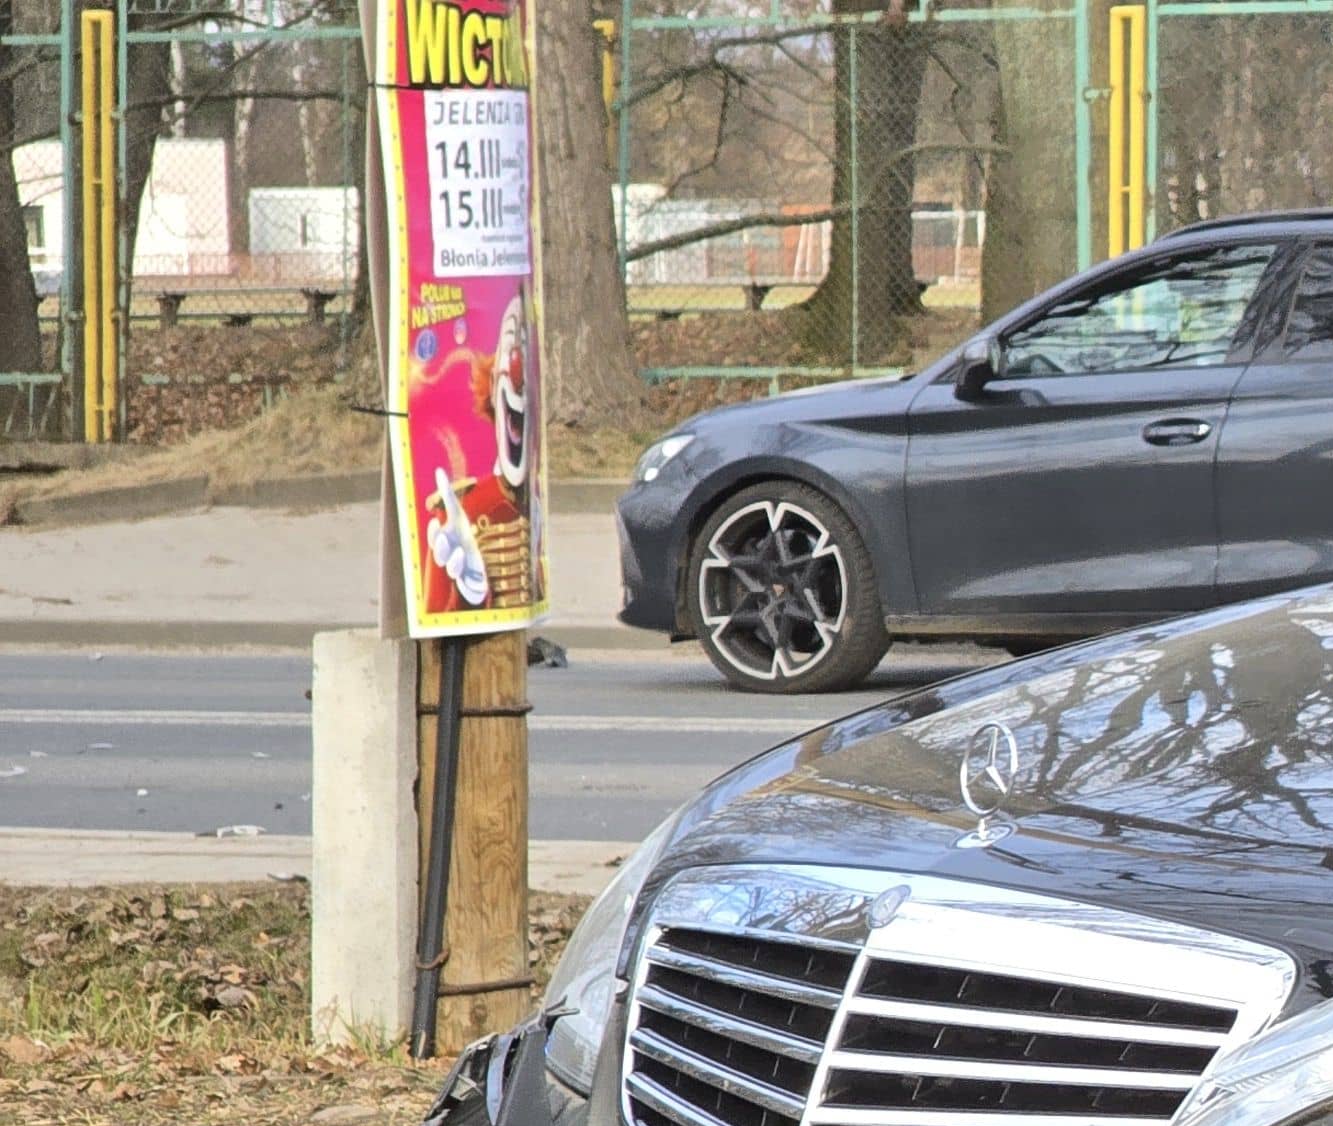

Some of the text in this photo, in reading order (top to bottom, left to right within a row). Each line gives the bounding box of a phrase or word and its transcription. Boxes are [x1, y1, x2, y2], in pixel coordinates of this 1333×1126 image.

[433, 101, 510, 125] JELENIA
[435, 139, 501, 179] 14.III
[440, 188, 504, 229] 15.III
[441, 248, 488, 267] Błonia
